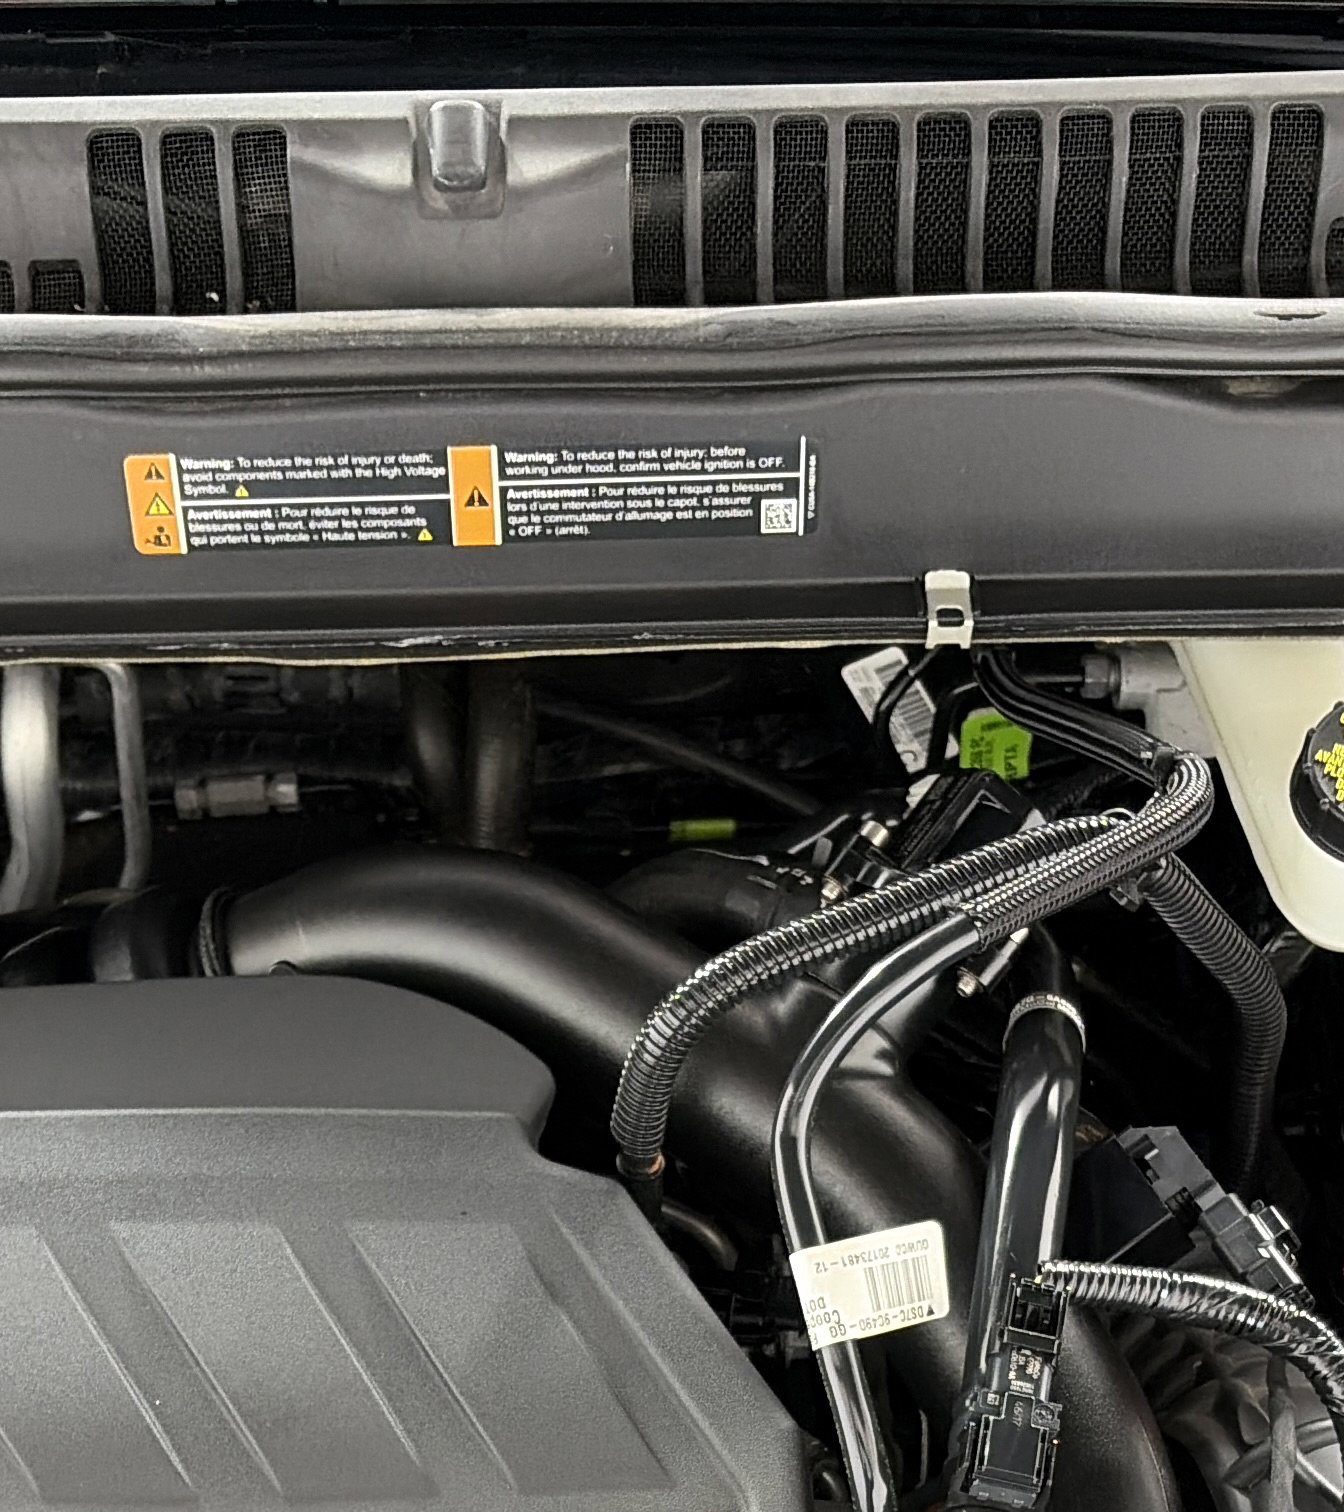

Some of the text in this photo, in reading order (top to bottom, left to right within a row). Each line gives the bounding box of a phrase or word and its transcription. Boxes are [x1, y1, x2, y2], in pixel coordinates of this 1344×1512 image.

[179, 458, 235, 471] Warning:
[237, 456, 251, 468] To
[253, 456, 292, 468] reduce
[294, 456, 312, 467] the
[314, 455, 335, 466] risk
[337, 454, 349, 465] of
[351, 454, 381, 467] injury
[384, 455, 396, 465] or
[504, 451, 559, 464] Warning:
[561, 449, 575, 462] To
[576, 449, 615, 461] reduce
[617, 449, 636, 460] the
[638, 448, 658, 459] risk
[660, 447, 672, 458] of
[709, 446, 746, 457] before
[182, 466, 446, 483] avoid components marked with the High Voltage
[505, 465, 549, 477] working
[550, 464, 583, 475] under
[618, 461, 660, 472] confirm
[663, 459, 702, 471] vehicle
[703, 458, 744, 472] ignition
[745, 458, 756, 469] is
[758, 457, 785, 469] OFF.
[183, 483, 229, 497] Symbol.
[506, 482, 784, 500] Avertissement Pour réduire le risque de blessures
[187, 507, 272, 520] Avertissement
[281, 507, 308, 518] Pour
[351, 505, 362, 516] le
[364, 505, 399, 517] risque
[400, 504, 416, 515] de
[506, 501, 528, 512] lors
[529, 500, 560, 511] d'une
[561, 499, 624, 510] intervention
[626, 498, 652, 508] sous
[654, 496, 664, 507] le
[702, 495, 753, 506] s'assurer
[187, 521, 242, 533] blessures
[243, 522, 259, 532] ou
[260, 520, 276, 531] de
[308, 519, 339, 530] éviter
[341, 518, 359, 529] les
[360, 517, 427, 529] composants
[507, 508, 753, 527] que le commutateur d'allumage est en position
[189, 530, 398, 547] qui portent le symbole Haute tension
[517, 525, 542, 537] OFF
